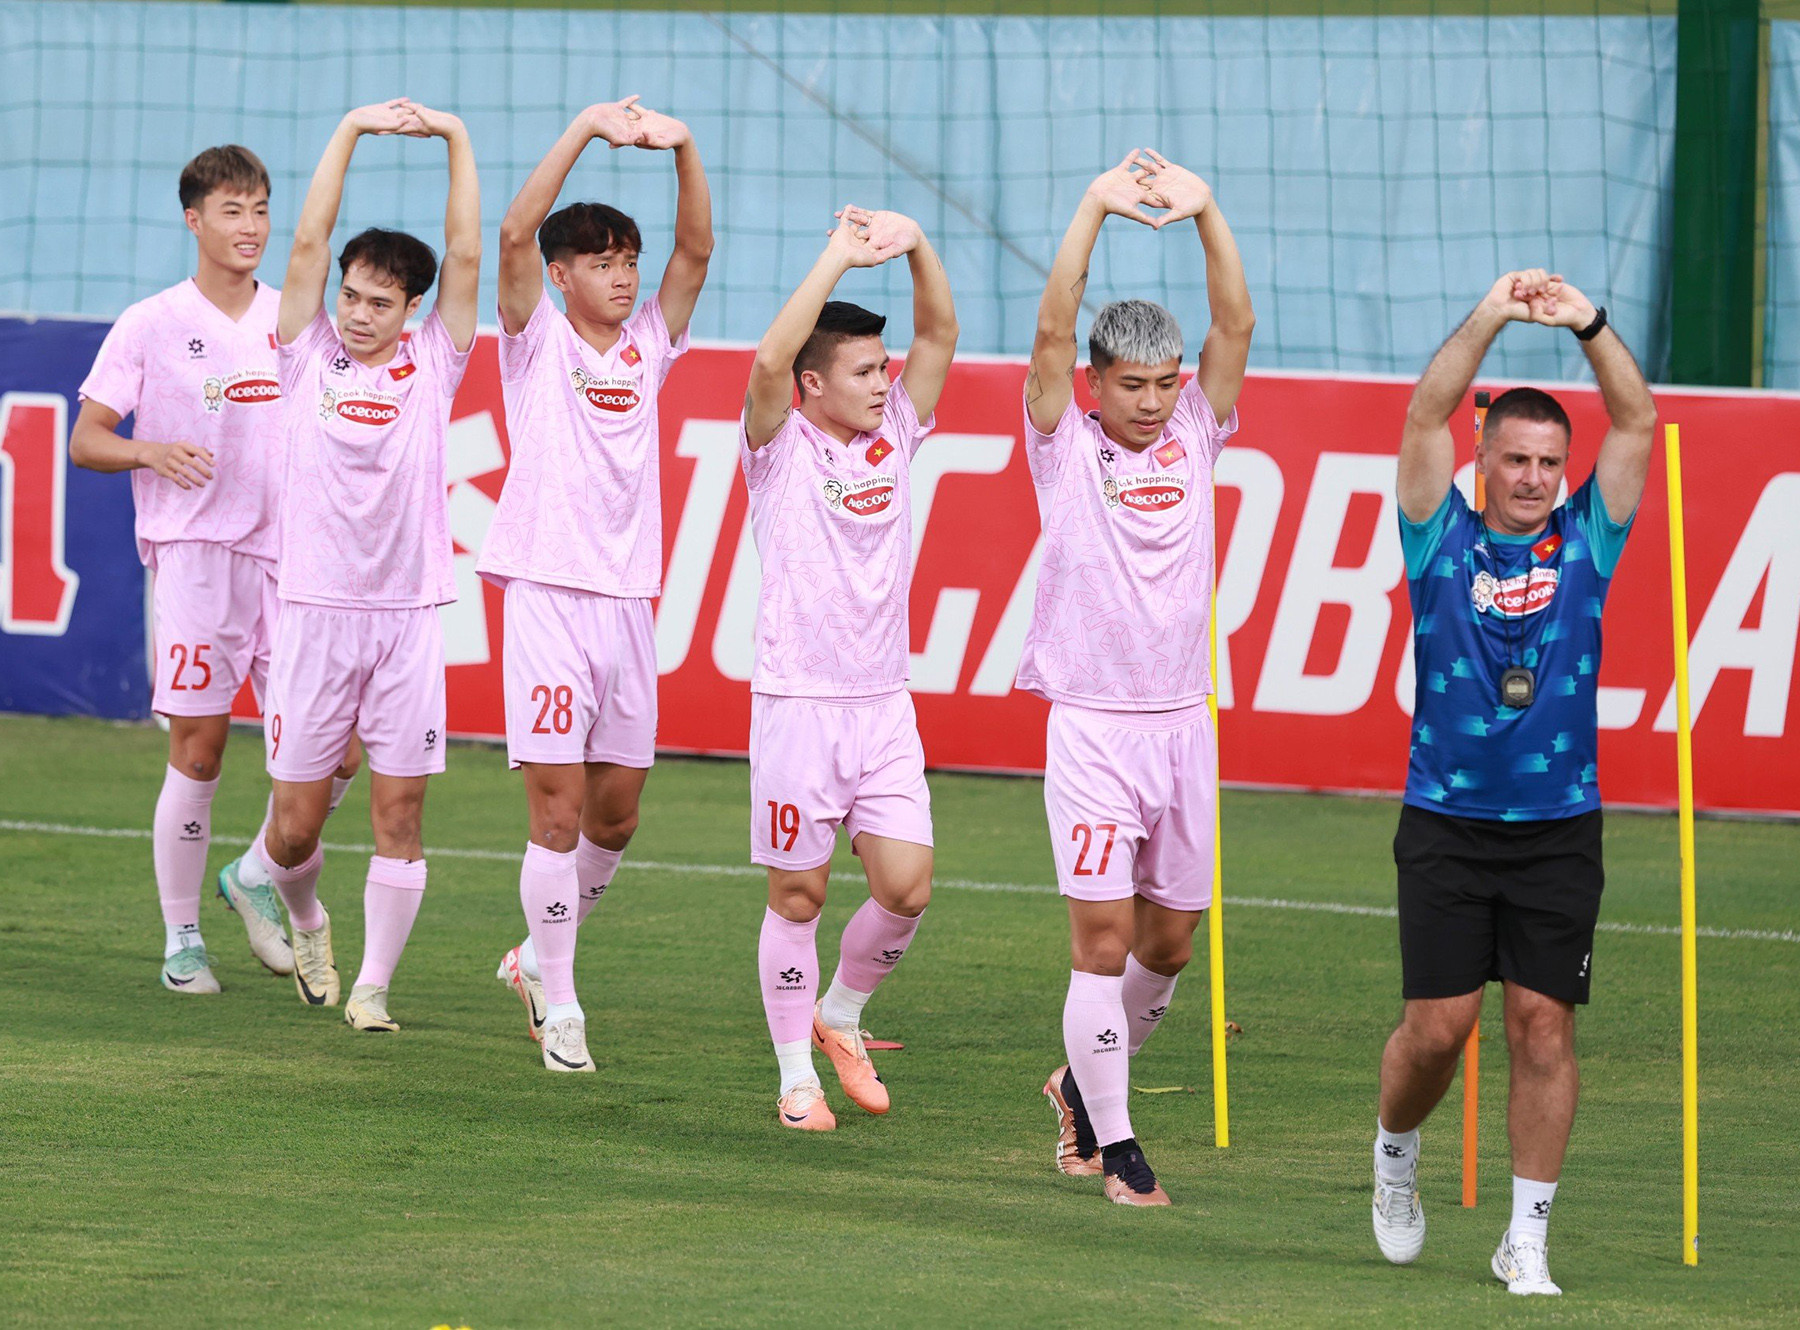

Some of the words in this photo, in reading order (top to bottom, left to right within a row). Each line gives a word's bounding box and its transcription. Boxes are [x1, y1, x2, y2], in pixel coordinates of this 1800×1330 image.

[1135, 473, 1185, 486] happiness
[170, 643, 212, 691] 25
[531, 684, 573, 735] 28
[272, 713, 282, 760] 9
[767, 800, 800, 852] 19
[1071, 823, 1118, 876] 27
